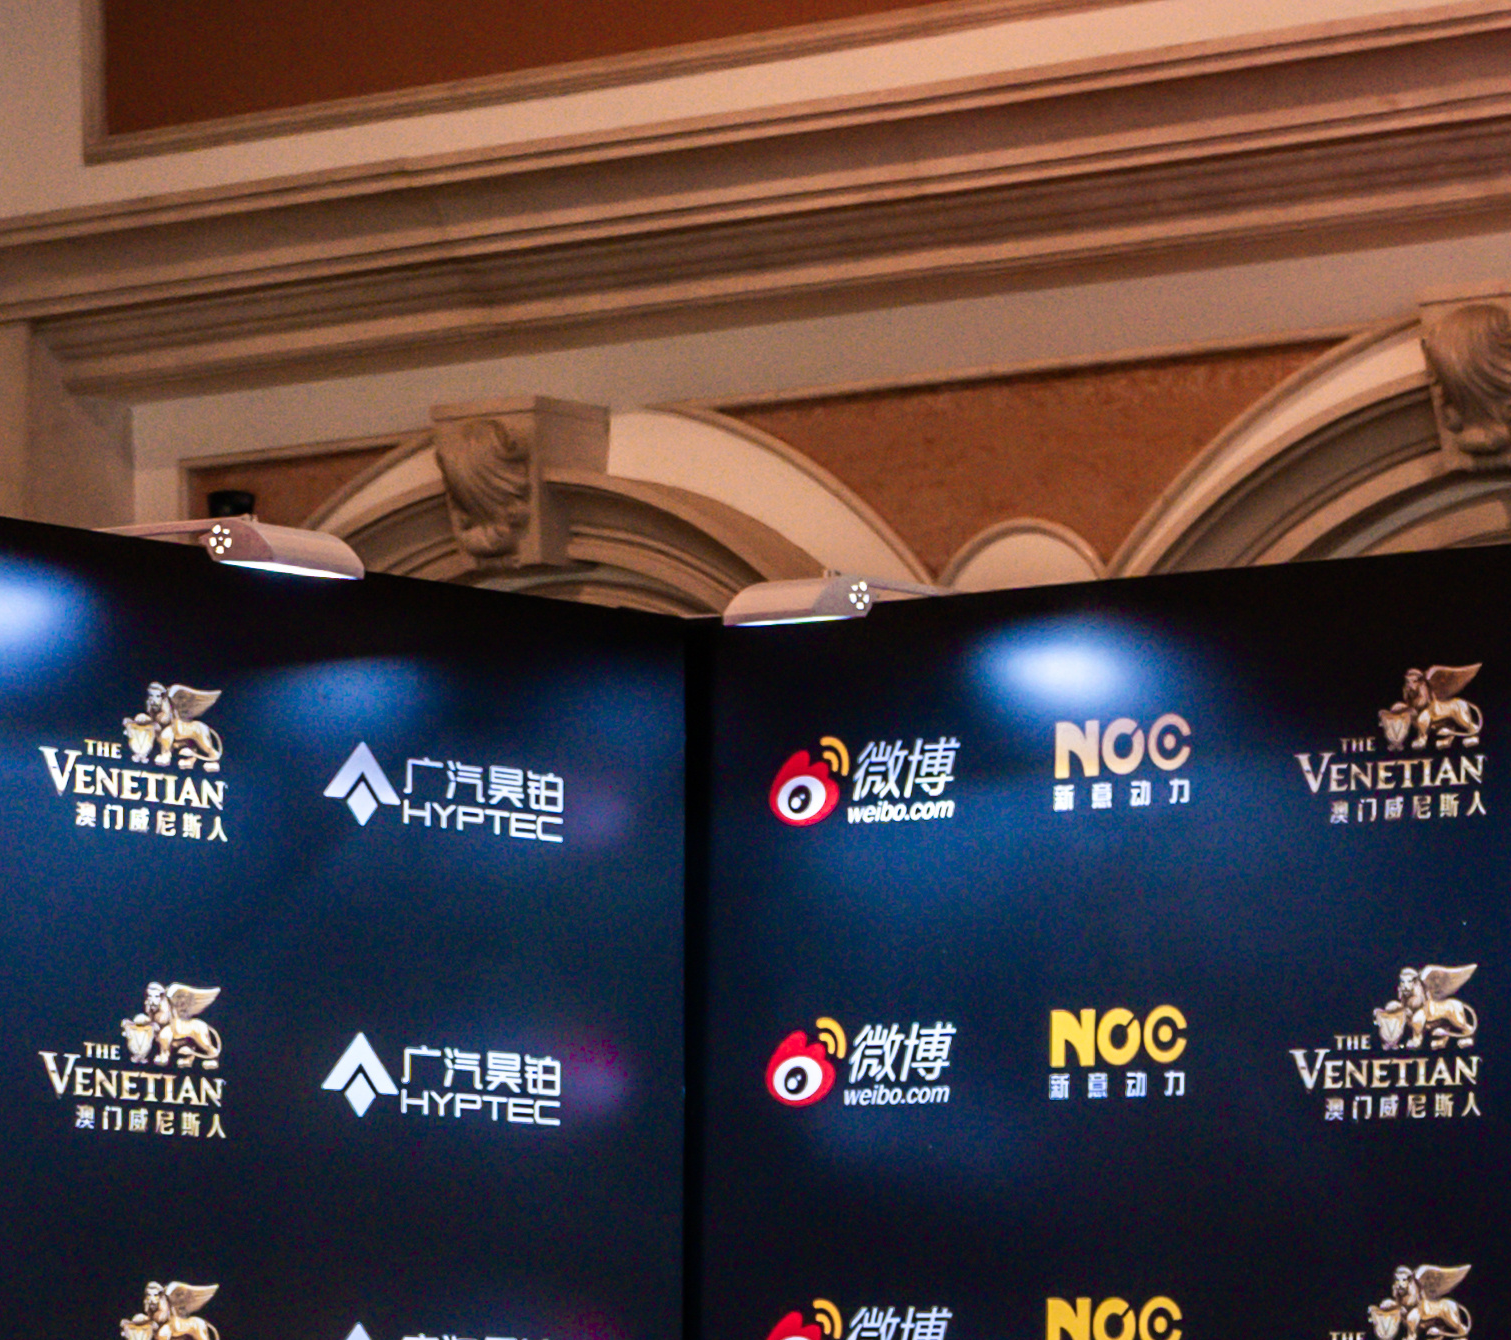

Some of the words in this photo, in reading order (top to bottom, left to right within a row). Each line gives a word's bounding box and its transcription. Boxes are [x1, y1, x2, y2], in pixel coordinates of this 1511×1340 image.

[38, 745, 229, 811] VENETIAN
[401, 756, 565, 813] 广汽昊铂
[852, 736, 961, 801] 微博
[1294, 752, 1485, 794] VENETIAN
[846, 799, 956, 825] weibo.com
[38, 1050, 227, 1108] VENETIAN
[1288, 1048, 1480, 1090] VENETIAN
[843, 1083, 951, 1107] weibo.com
